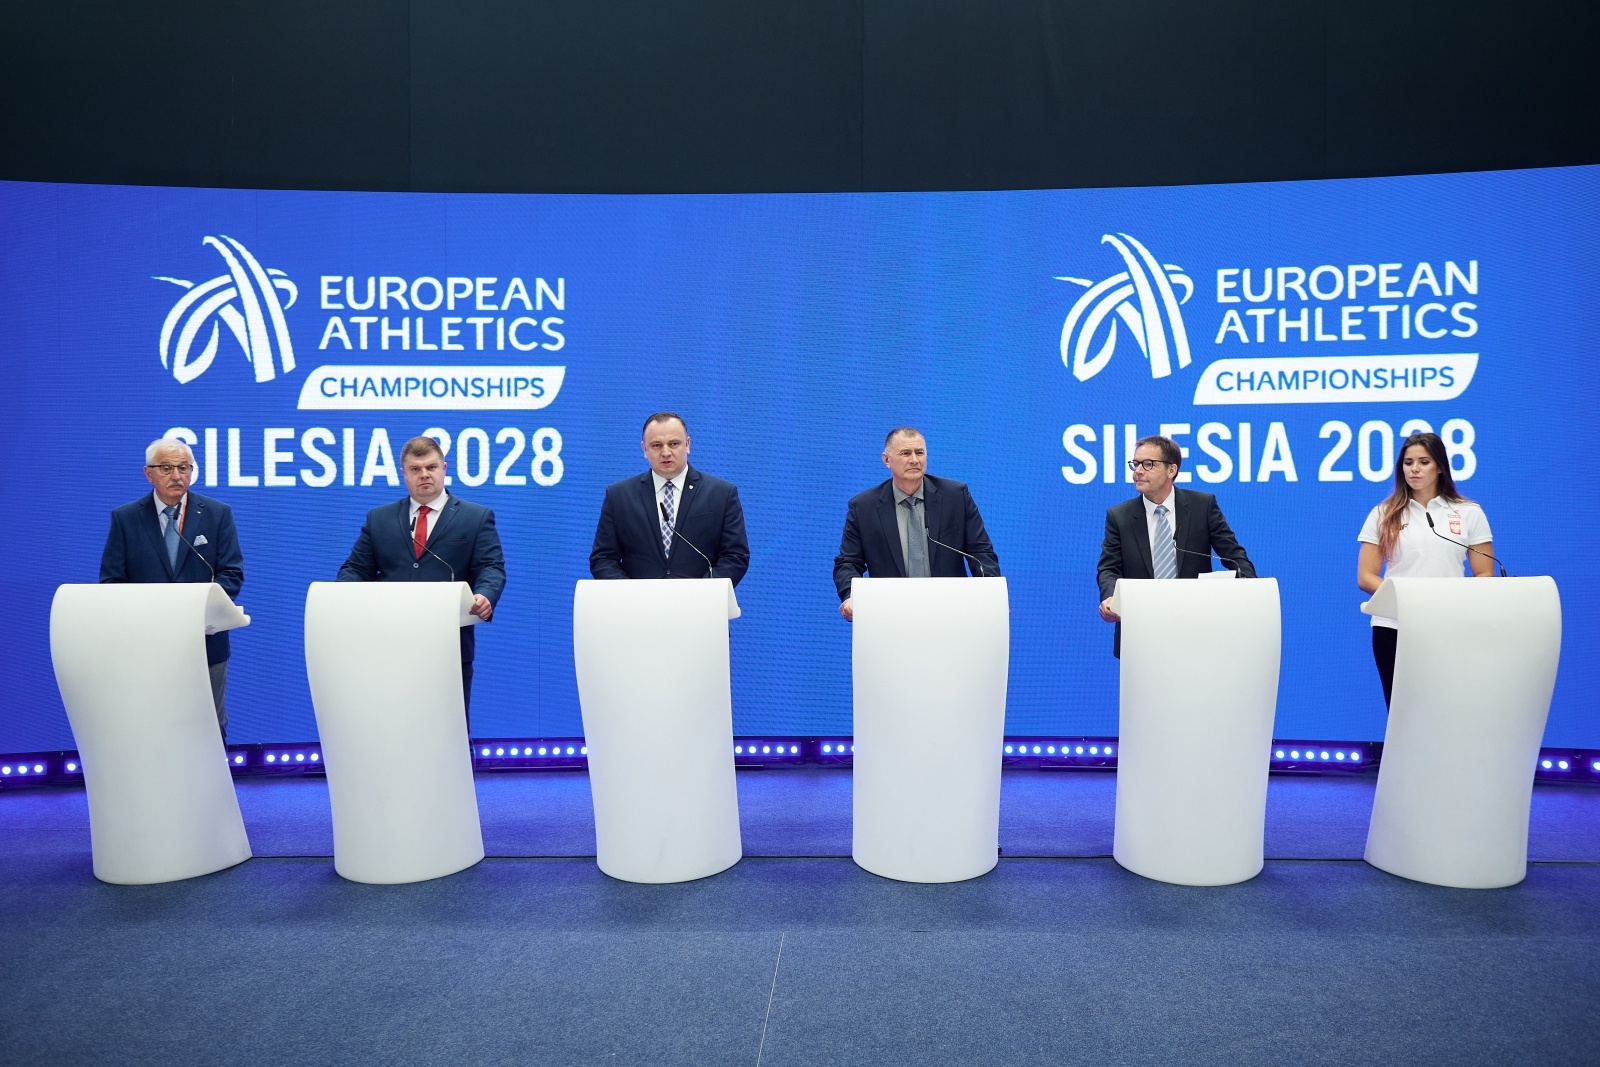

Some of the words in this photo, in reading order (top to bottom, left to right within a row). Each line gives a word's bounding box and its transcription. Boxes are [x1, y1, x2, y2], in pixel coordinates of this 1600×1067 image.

[320, 275, 565, 310] EUROPEAN
[1217, 260, 1478, 303] EUROPEAN
[318, 316, 565, 351] ATHLETICS
[1215, 302, 1478, 344] ATHLETICS
[319, 376, 545, 398] CHAMPIONSHIPS
[1215, 366, 1455, 392] CHAMPIONSHIPS
[1318, 418, 1477, 482] 208
